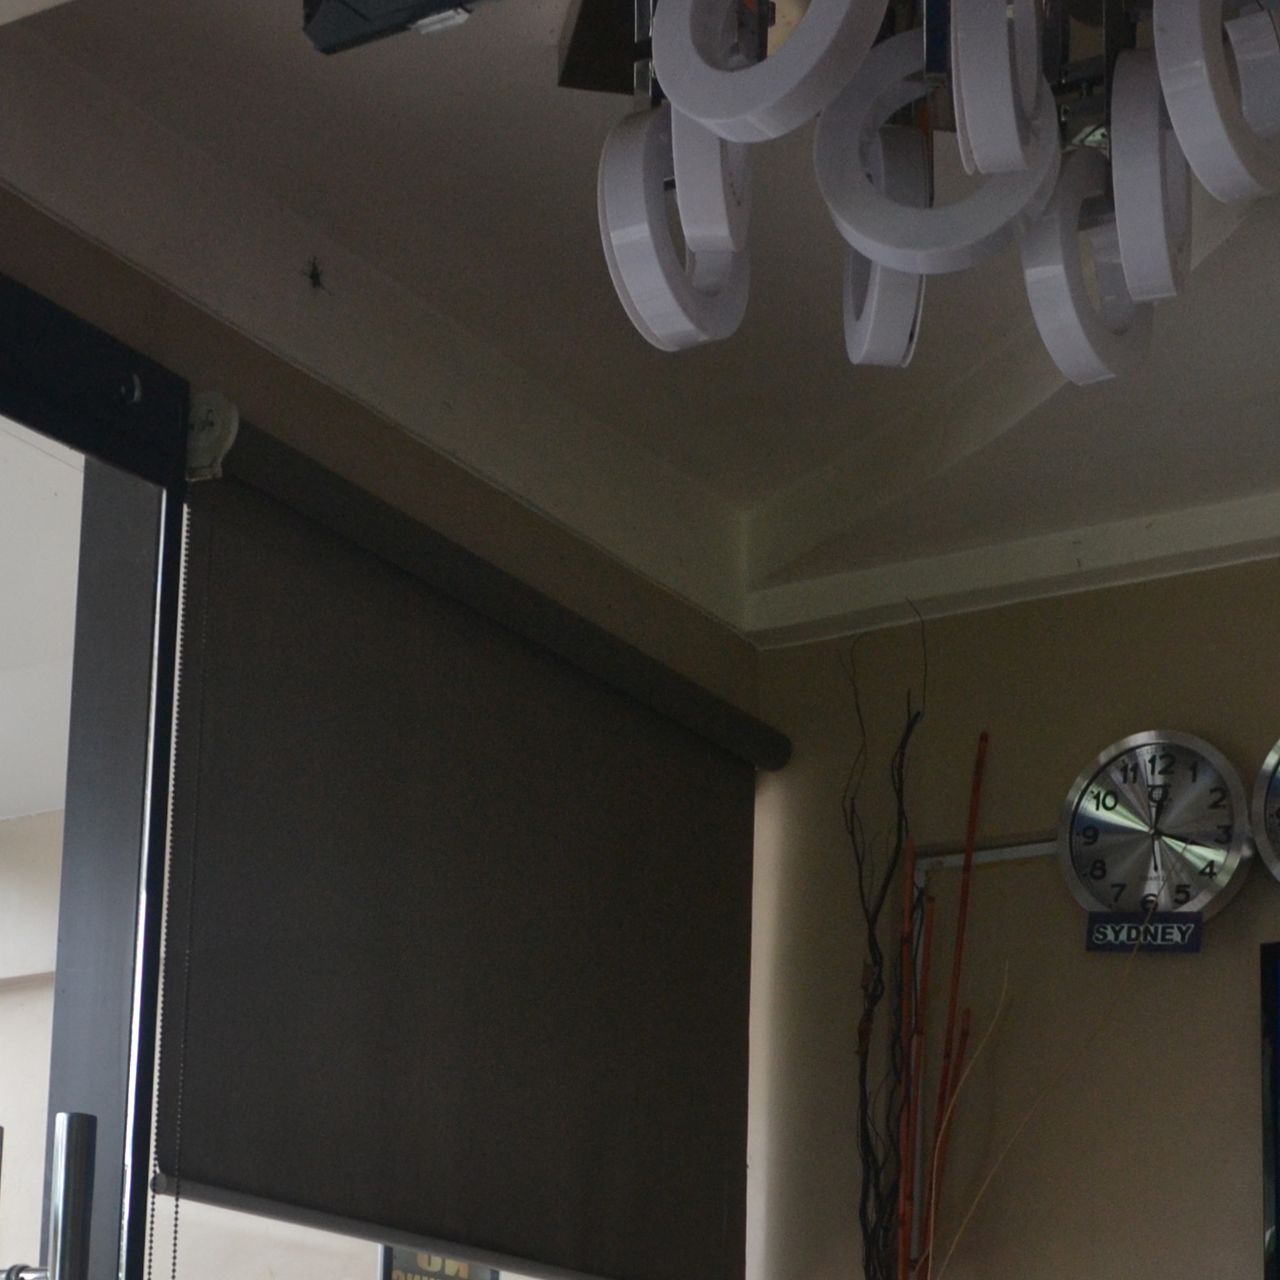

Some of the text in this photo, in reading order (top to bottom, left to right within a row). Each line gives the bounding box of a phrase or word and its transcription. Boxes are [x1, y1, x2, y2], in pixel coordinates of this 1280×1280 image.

[1120, 763, 1139, 784] 11
[1148, 754, 1174, 775] 12
[1190, 762, 1197, 782] 1
[1093, 791, 1118, 811] 10
[1209, 787, 1226, 809] 2
[1082, 826, 1099, 845] 9
[1215, 826, 1232, 844] 3
[1090, 860, 1106, 879] 8
[1200, 861, 1216, 878] 4
[1111, 884, 1126, 902] 7
[1140, 893, 1158, 912] 6
[1175, 884, 1191, 903] 5
[1093, 924, 1195, 945] SYDNEY
